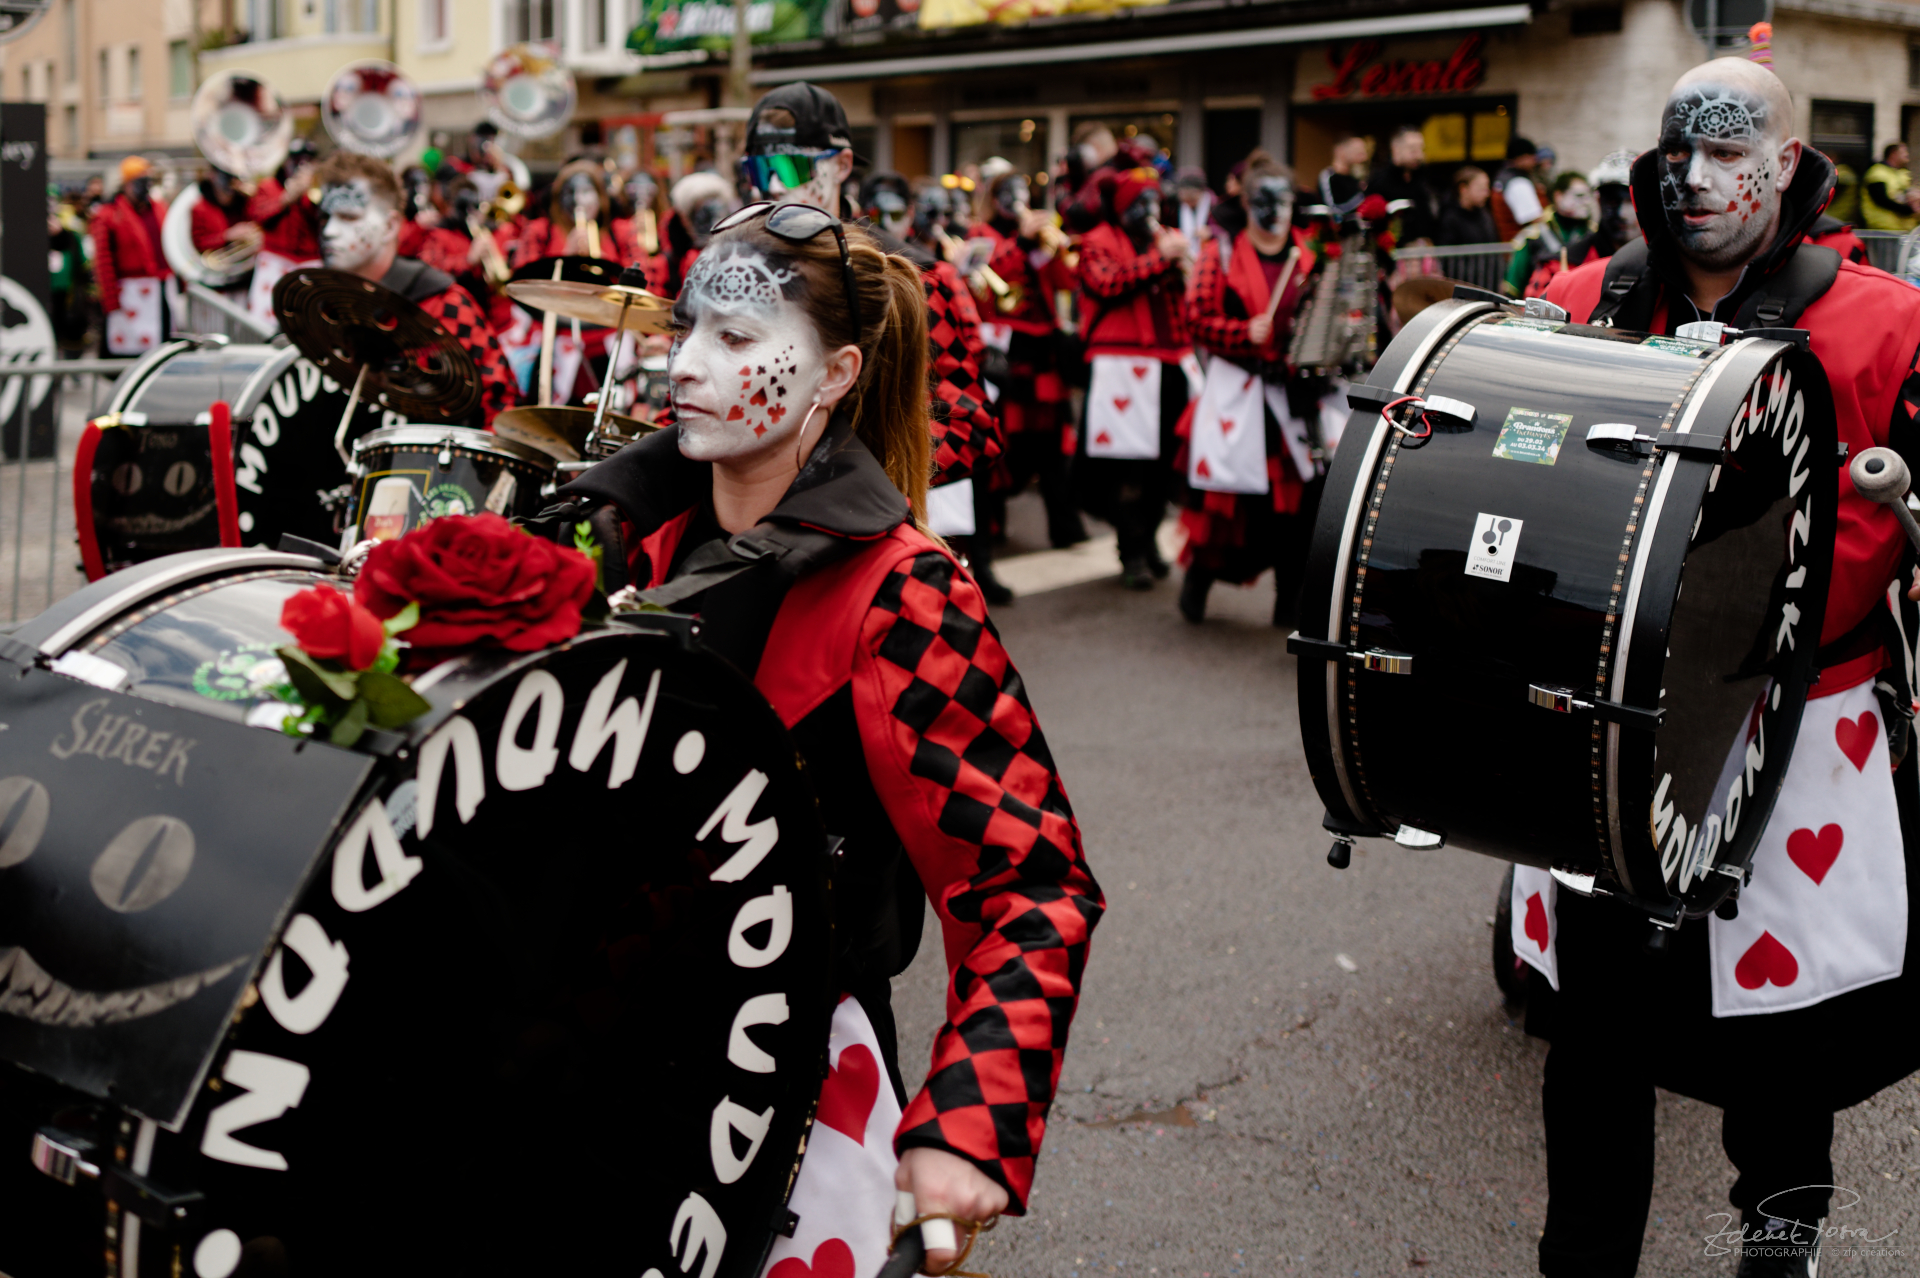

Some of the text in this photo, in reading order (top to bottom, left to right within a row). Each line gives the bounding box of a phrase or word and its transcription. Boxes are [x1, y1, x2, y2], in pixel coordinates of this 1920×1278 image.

[1513, 422, 1556, 434] Brandons
[1517, 443, 1546, 452] 03.03.24
[1479, 564, 1504, 576] SONOR
[640, 767, 793, 1278] MOUDE
